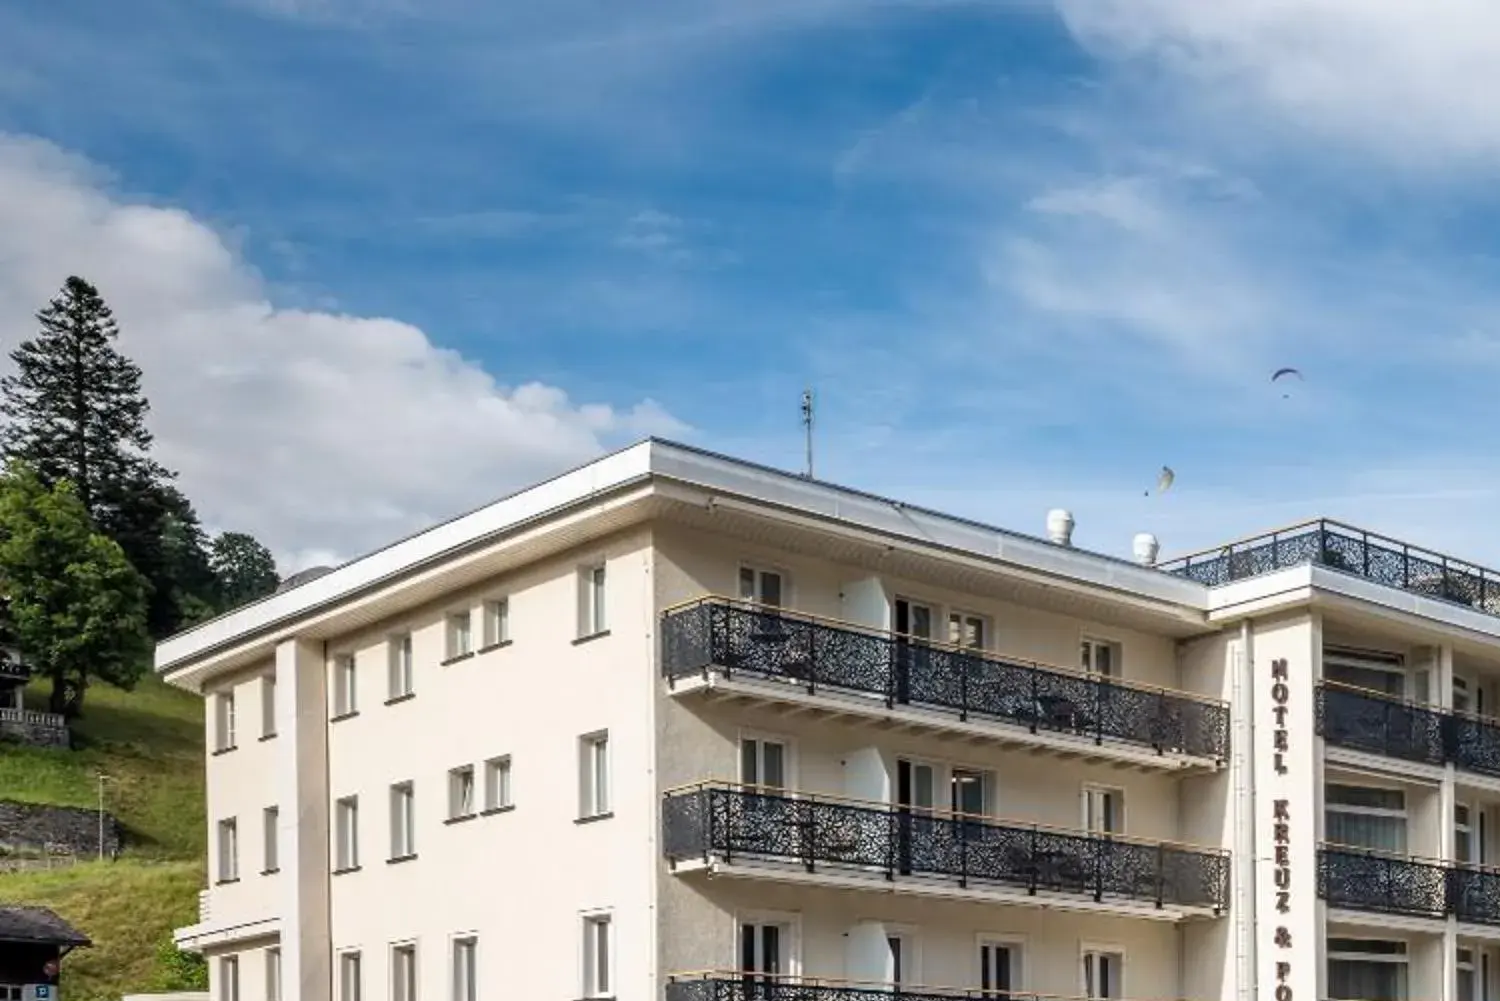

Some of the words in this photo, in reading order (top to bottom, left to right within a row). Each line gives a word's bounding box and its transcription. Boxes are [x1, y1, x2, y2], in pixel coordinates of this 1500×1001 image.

[1271, 657, 1289, 776] HOTEL
[1273, 799, 1290, 915] KREUZ
[1273, 925, 1292, 949] &
